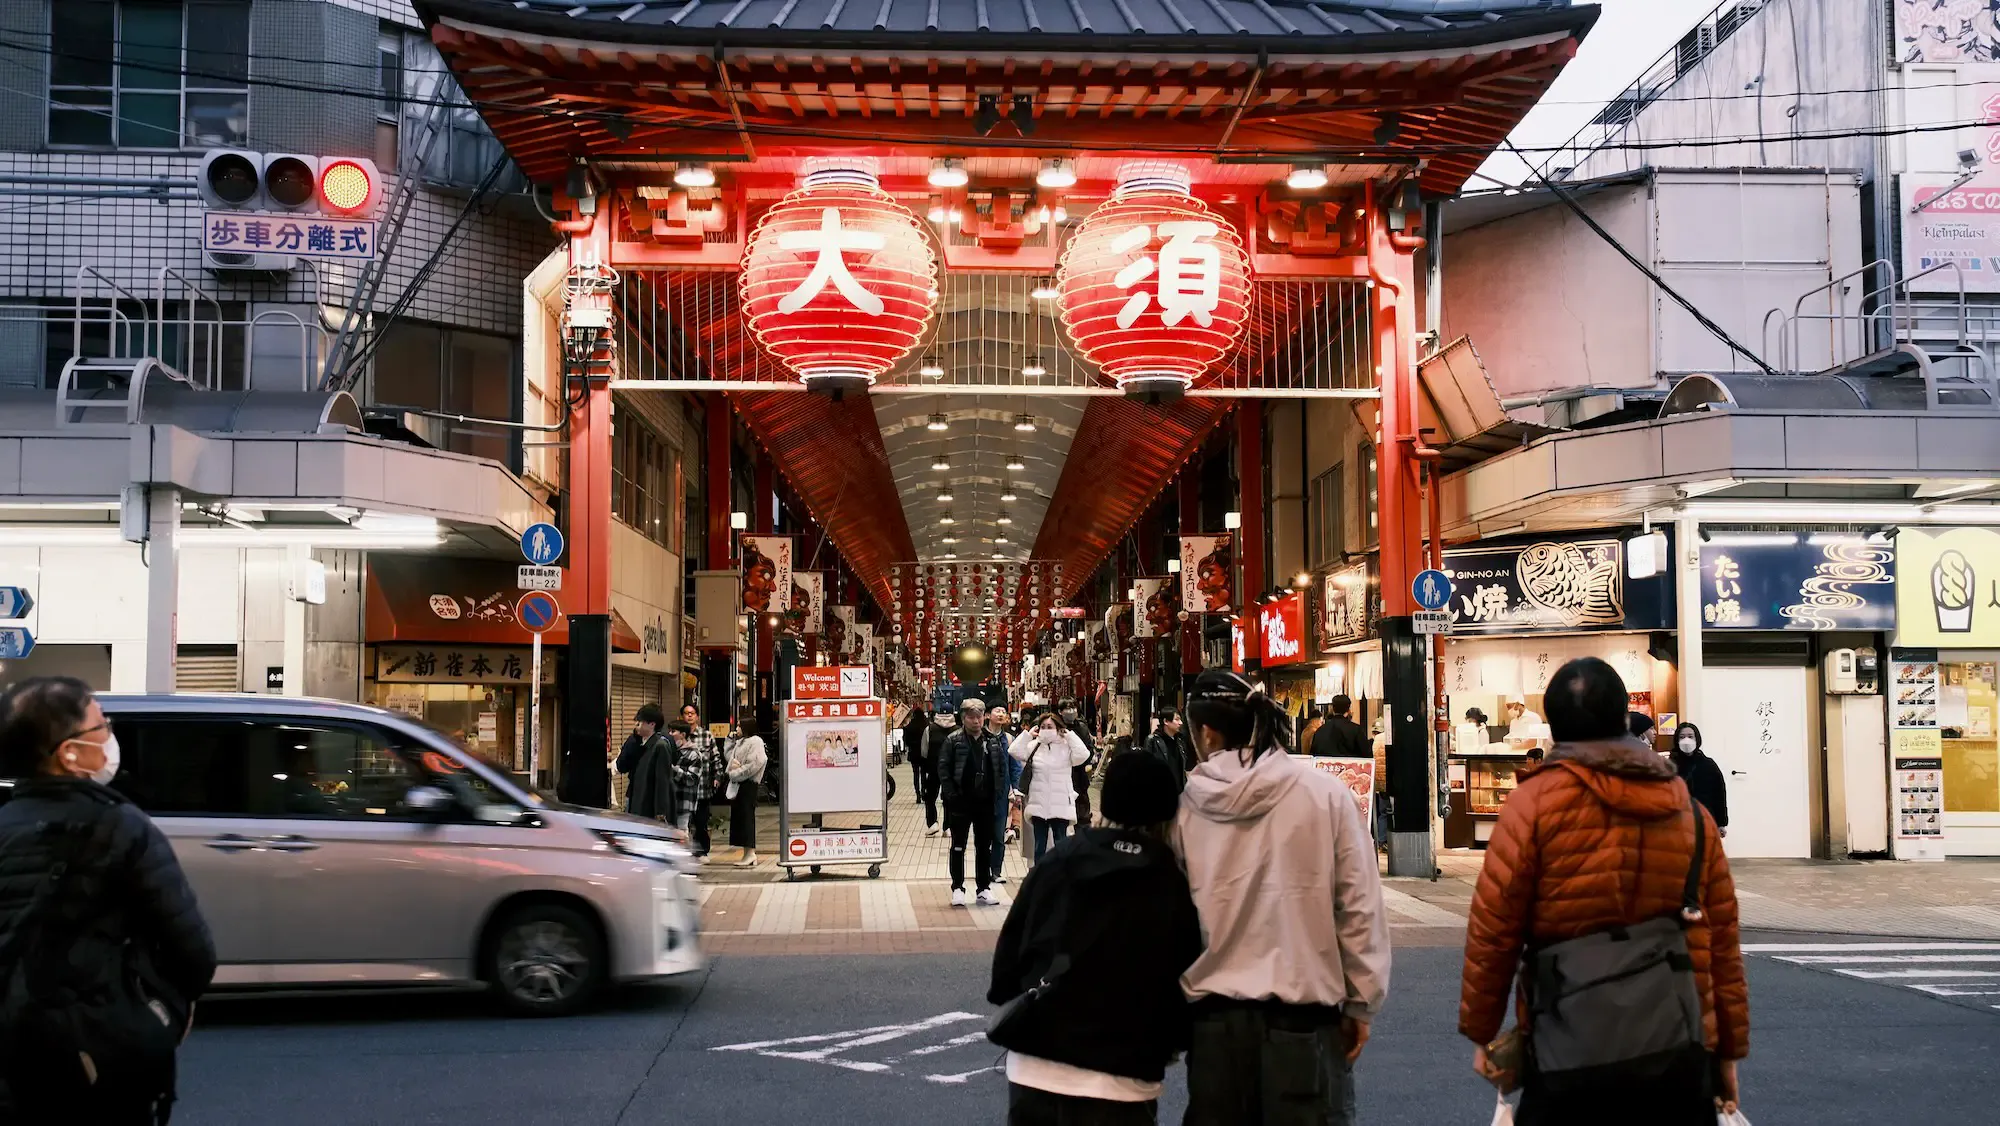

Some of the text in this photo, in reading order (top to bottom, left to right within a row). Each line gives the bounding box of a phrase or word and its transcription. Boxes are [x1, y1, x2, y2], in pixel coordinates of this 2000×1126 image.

[211, 219, 367, 253] 歩車分離式
[1924, 227, 1985, 240] Kleinpalast
[777, 207, 884, 315] 大
[1111, 221, 1220, 329] 須
[1456, 569, 1510, 580] GIN-NO AN
[523, 579, 556, 588] 11-22
[1714, 555, 1741, 622] たい焼
[431, 597, 454, 606] 大須
[436, 607, 458, 616] 名物
[1418, 623, 1449, 632] 11-22
[414, 651, 523, 680] 新雀本店
[1536, 653, 1549, 690] 銀のあん
[803, 674, 836, 682] Welcome
[1454, 655, 1467, 692] 銀のあん
[795, 704, 874, 716] 仁王門通り
[1755, 701, 1775, 755] 銀のあん
[813, 836, 881, 847] 車両進入禁止
